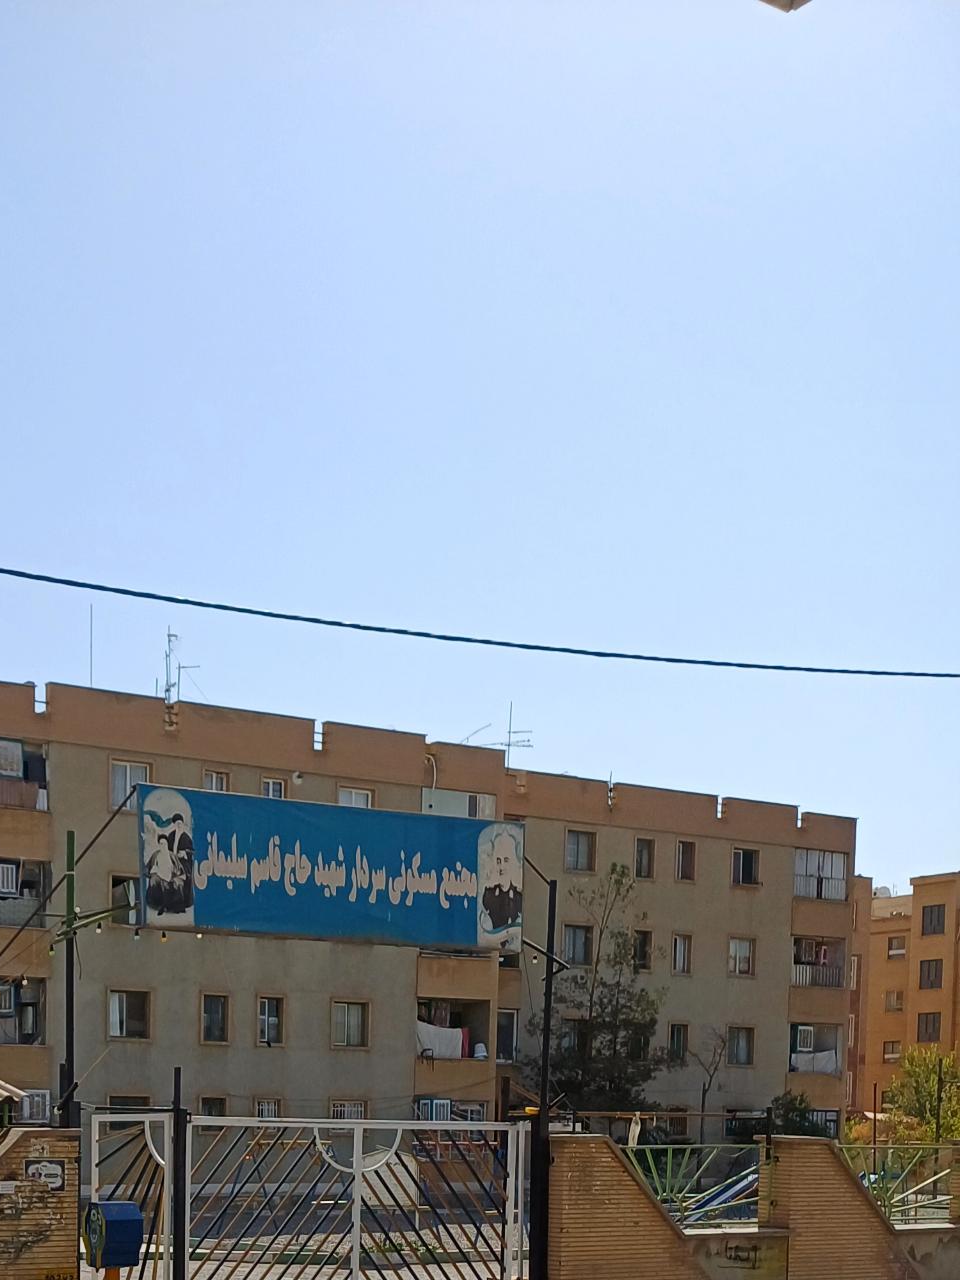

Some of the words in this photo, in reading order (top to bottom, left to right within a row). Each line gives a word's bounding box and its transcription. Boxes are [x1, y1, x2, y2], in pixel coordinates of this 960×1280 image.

[194, 832, 248, 889] سلیمانی
[250, 835, 282, 893] قاسم
[283, 840, 312, 896] حاج
[314, 845, 346, 897] شهید
[349, 846, 387, 904] سردار
[388, 850, 438, 907] مسکونی
[439, 862, 477, 910] مجتمع
